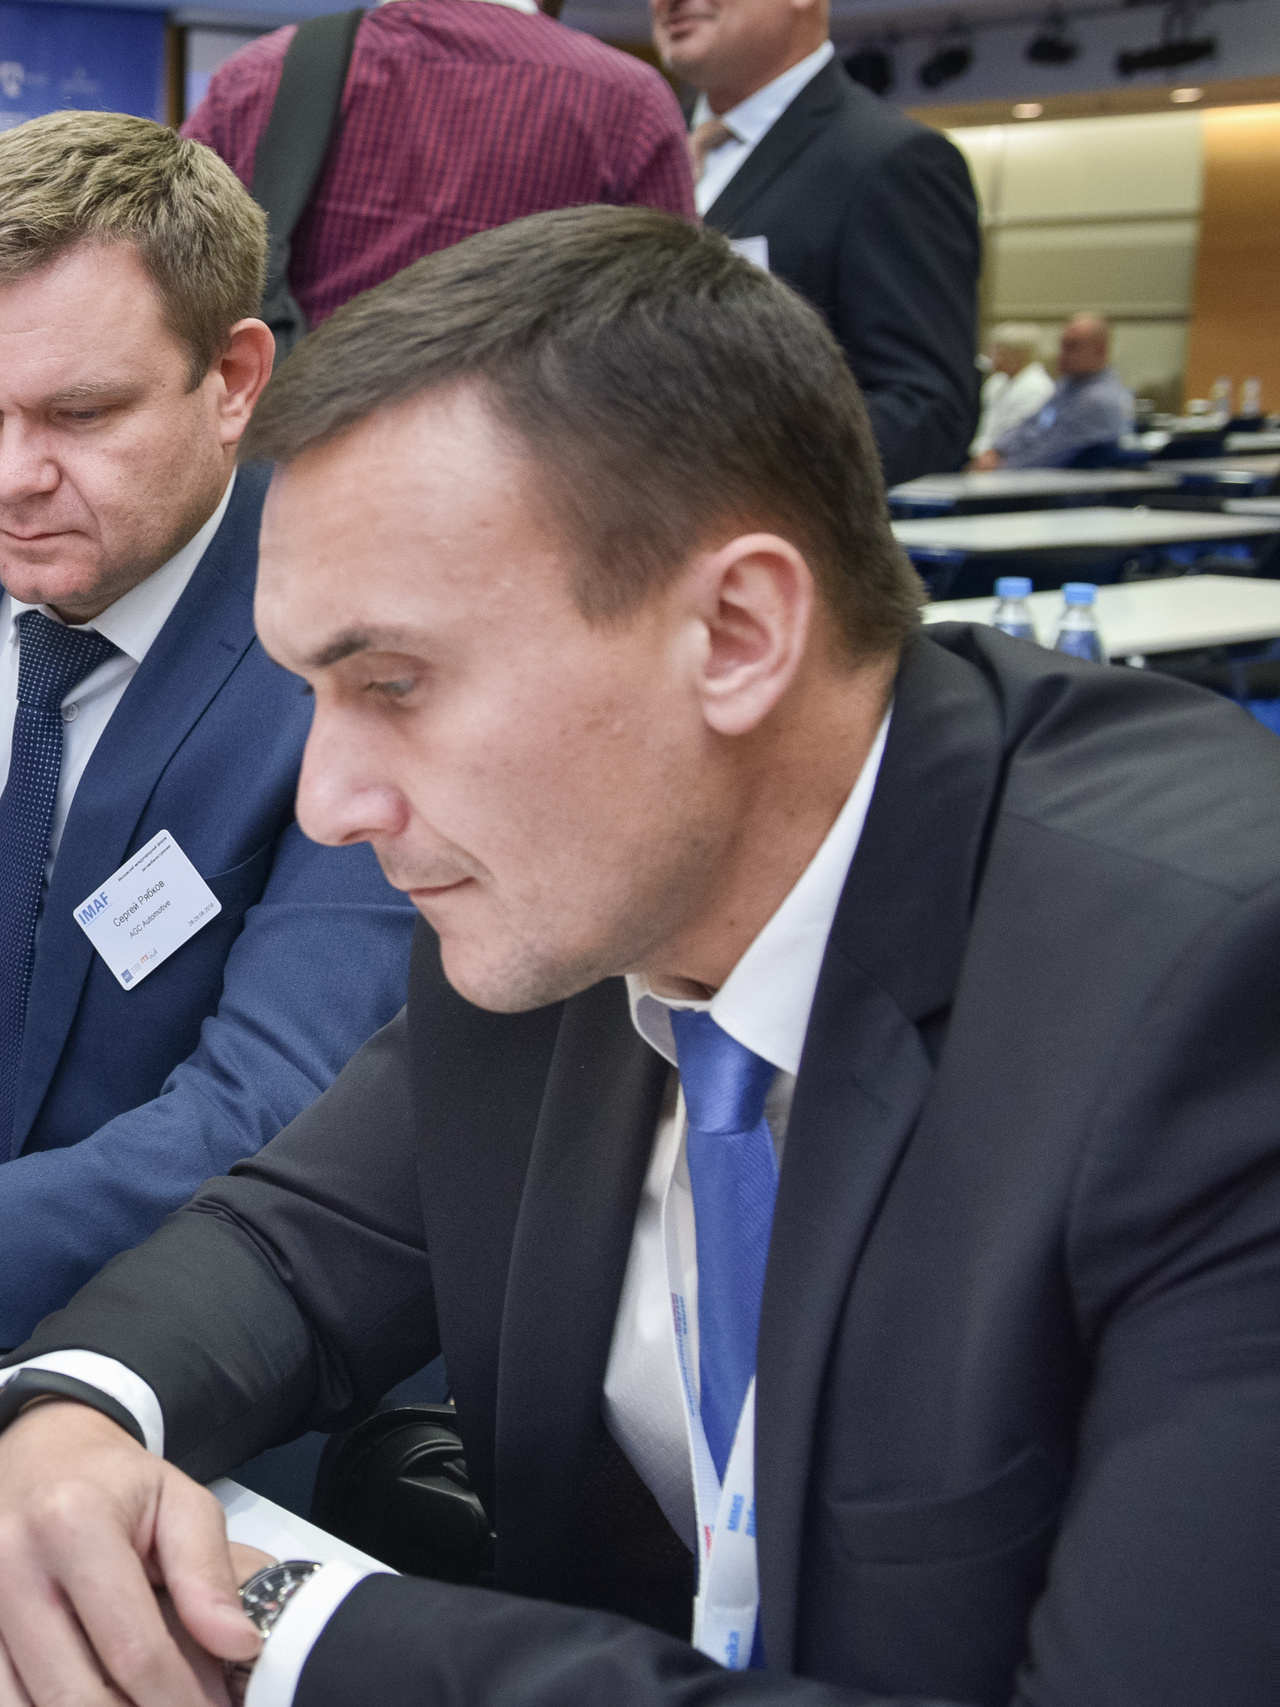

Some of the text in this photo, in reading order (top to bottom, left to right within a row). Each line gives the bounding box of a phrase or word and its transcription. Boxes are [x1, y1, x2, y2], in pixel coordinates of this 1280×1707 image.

[78, 891, 110, 925] IMAF
[113, 880, 165, 927] Сергей Рябков
[129, 900, 171, 939] AGC Automotive
[727, 1494, 745, 1532] MIMS
